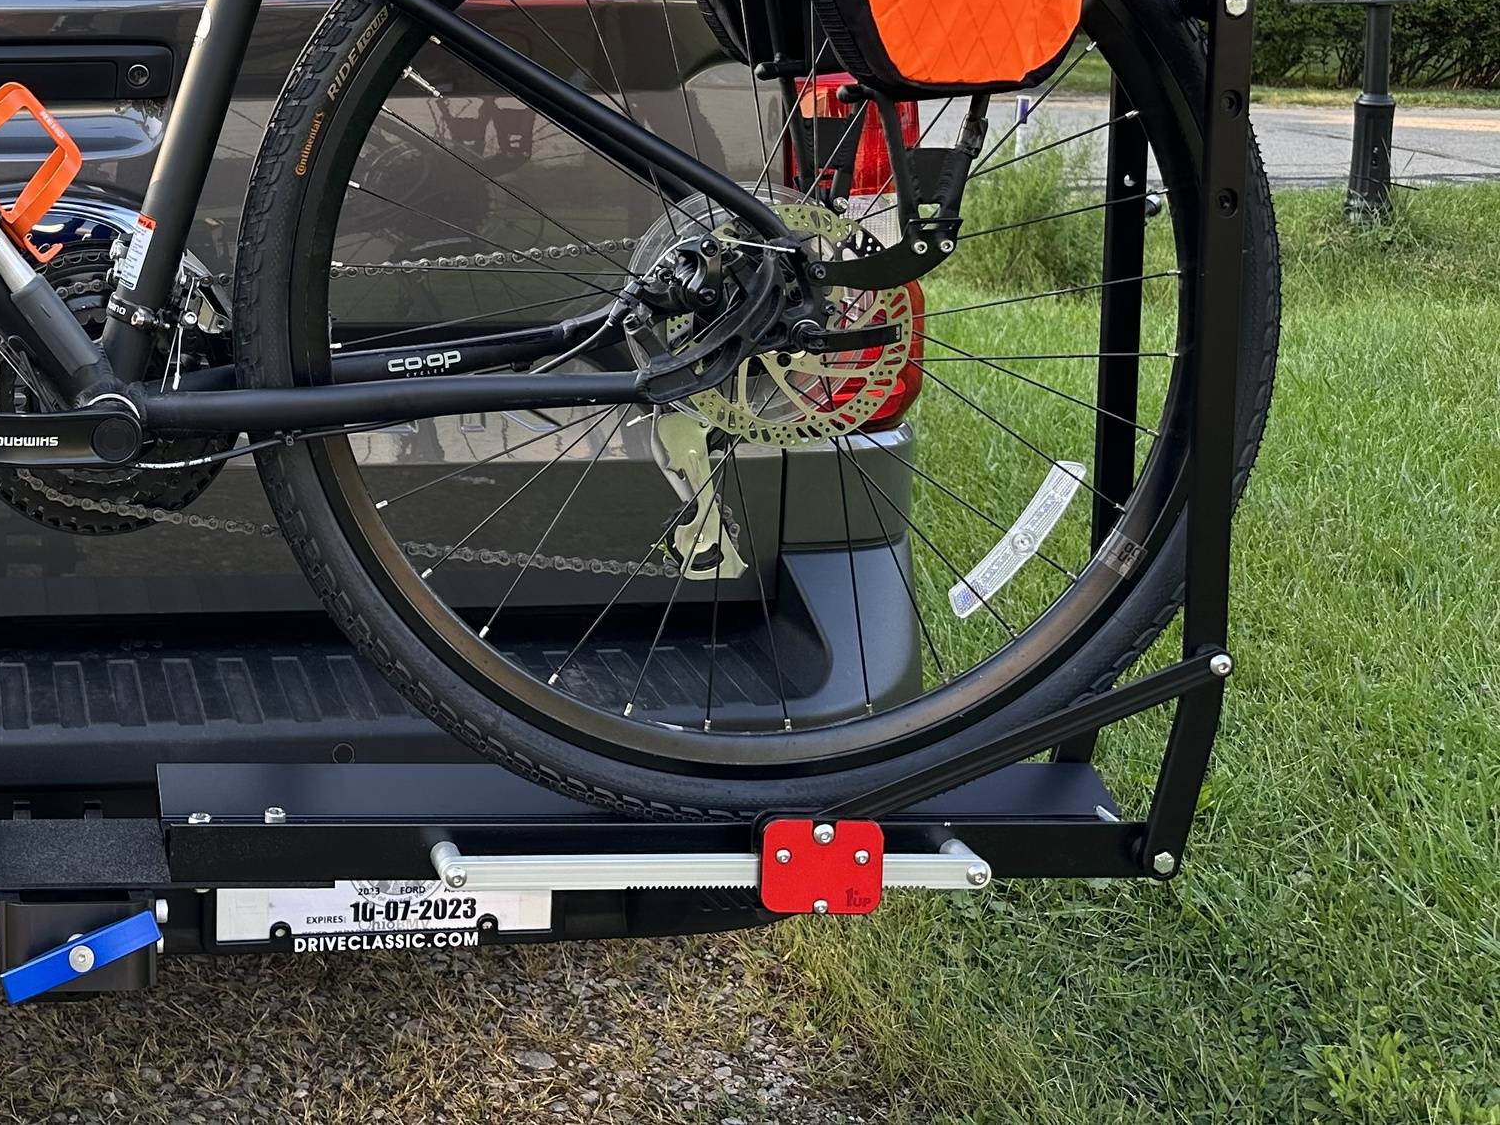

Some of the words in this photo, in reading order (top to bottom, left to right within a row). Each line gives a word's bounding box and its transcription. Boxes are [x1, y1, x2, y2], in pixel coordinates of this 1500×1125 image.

[400, 886, 426, 895] FORD
[350, 897, 477, 923] 10-07-2023
[294, 931, 480, 953] DRIVECLASSIC.COM
